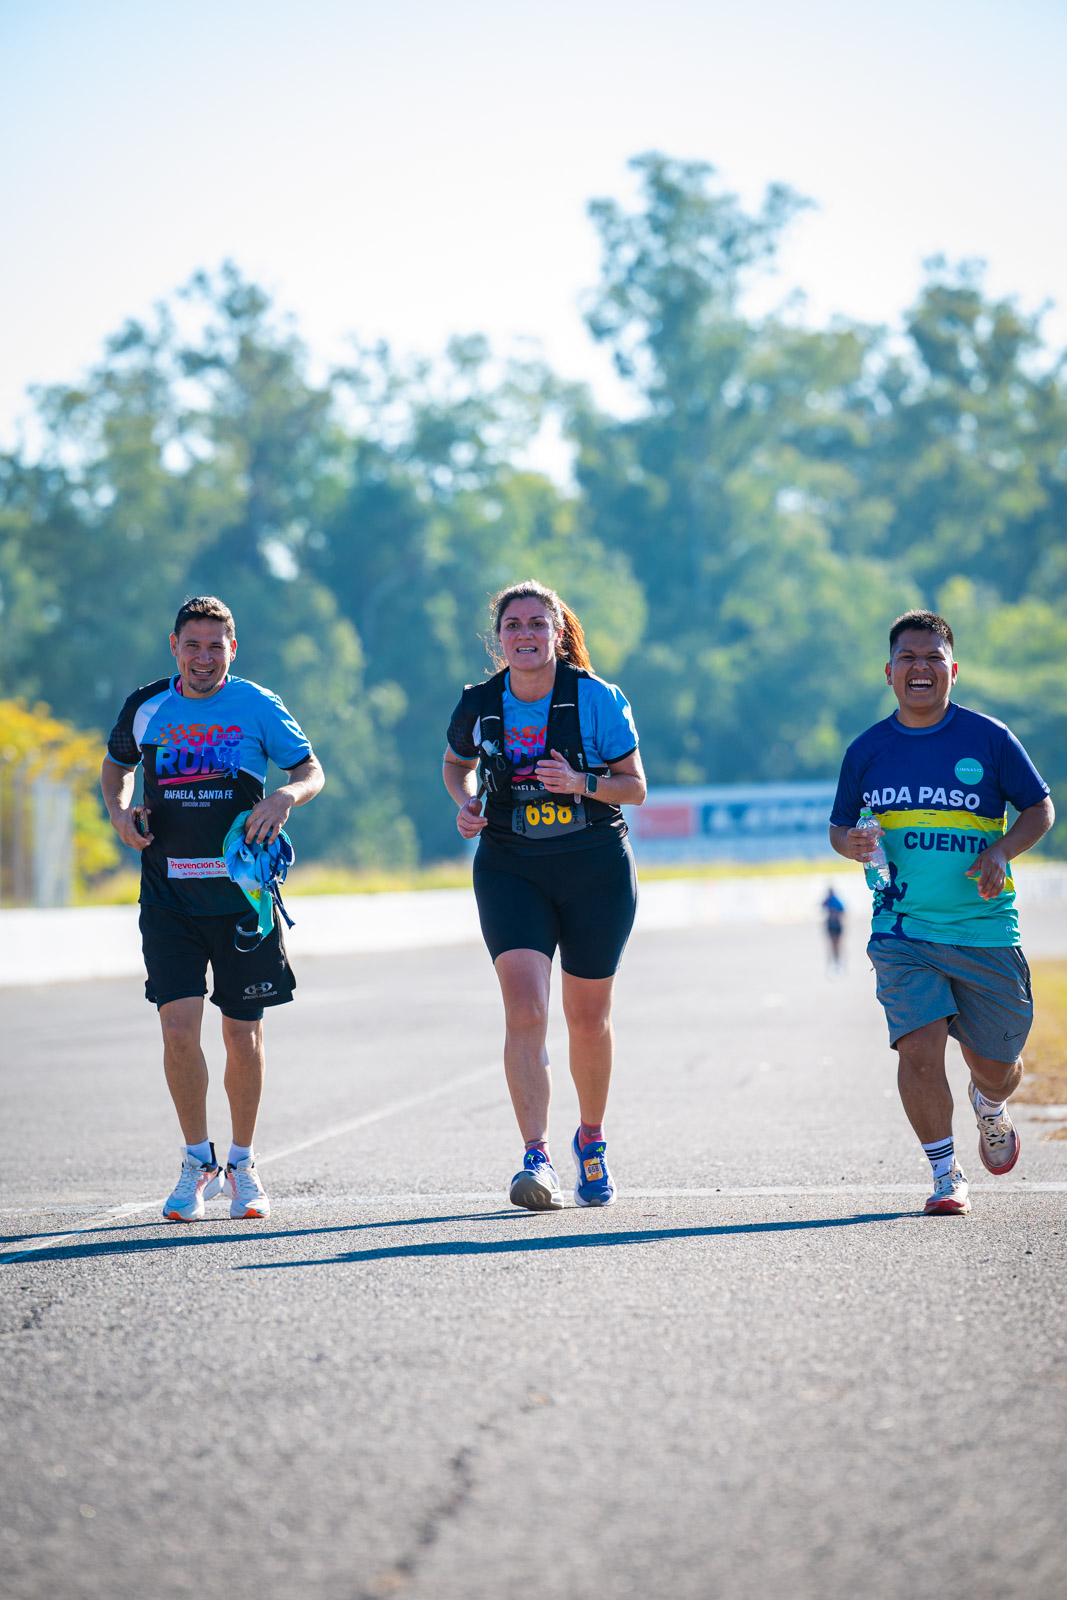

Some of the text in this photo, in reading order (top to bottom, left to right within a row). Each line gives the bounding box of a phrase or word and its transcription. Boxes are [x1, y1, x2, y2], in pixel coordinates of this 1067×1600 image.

[187, 724, 242, 747] 500
[216, 732, 244, 740] MILLAS
[155, 747, 232, 775] RUN
[164, 789, 233, 800] RAFAELA, SANTA FE
[862, 786, 980, 810] CADA PASO
[526, 801, 572, 826] 658
[903, 831, 989, 855] CUENTA
[170, 860, 226, 870] Prevención Sa
